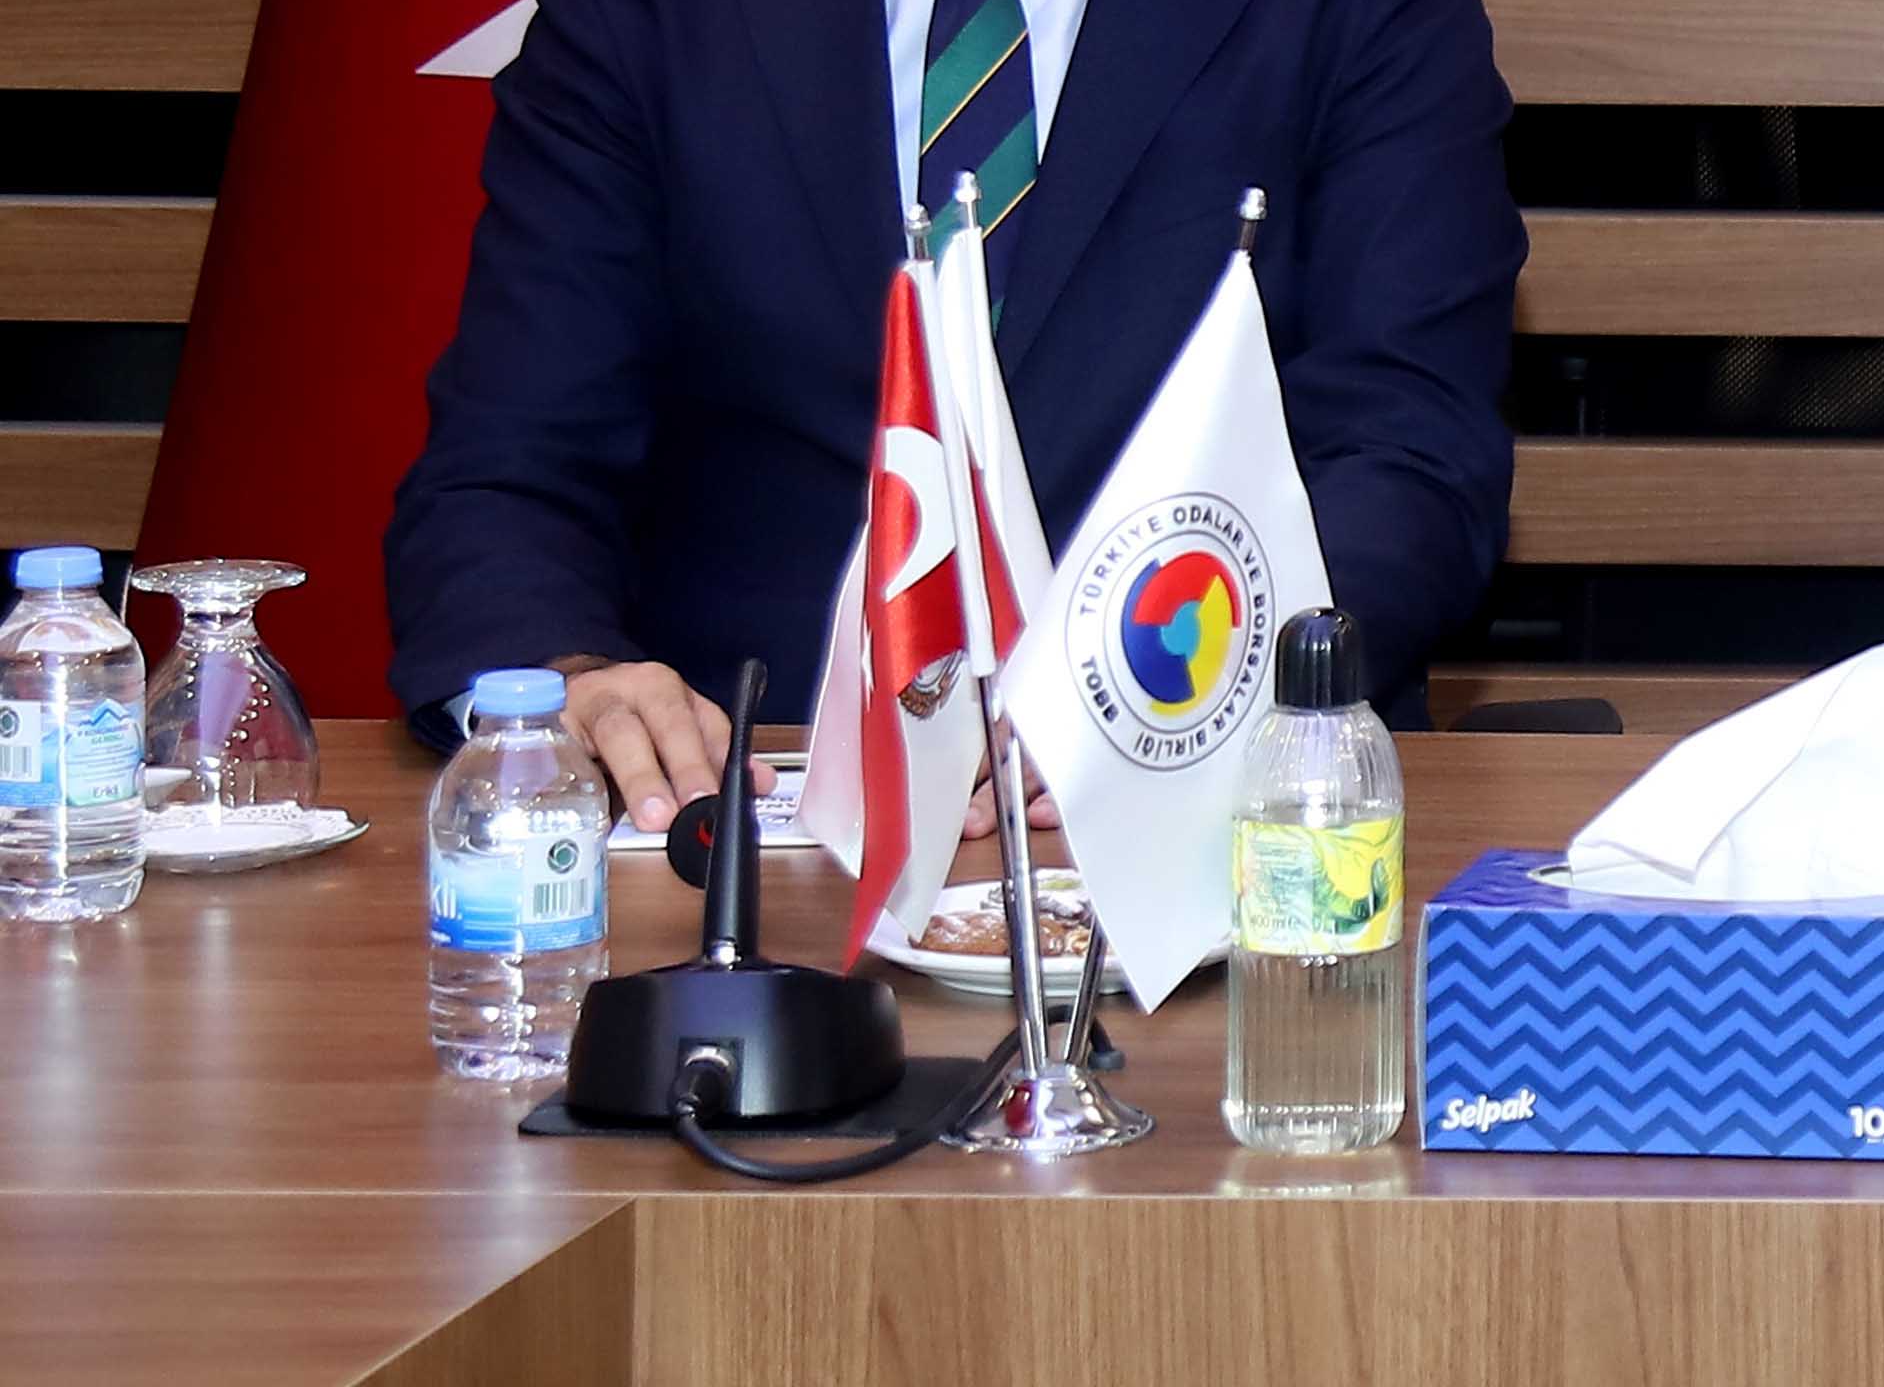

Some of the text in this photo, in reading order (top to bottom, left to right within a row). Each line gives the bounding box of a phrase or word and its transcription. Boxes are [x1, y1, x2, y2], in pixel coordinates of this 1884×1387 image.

[1172, 504, 1245, 547] ODALAR
[1243, 547, 1263, 581] VE
[1212, 592, 1266, 730] BORSALAR
[1081, 655, 1120, 724] TOBB
[1441, 1088, 1537, 1133] Selpak
